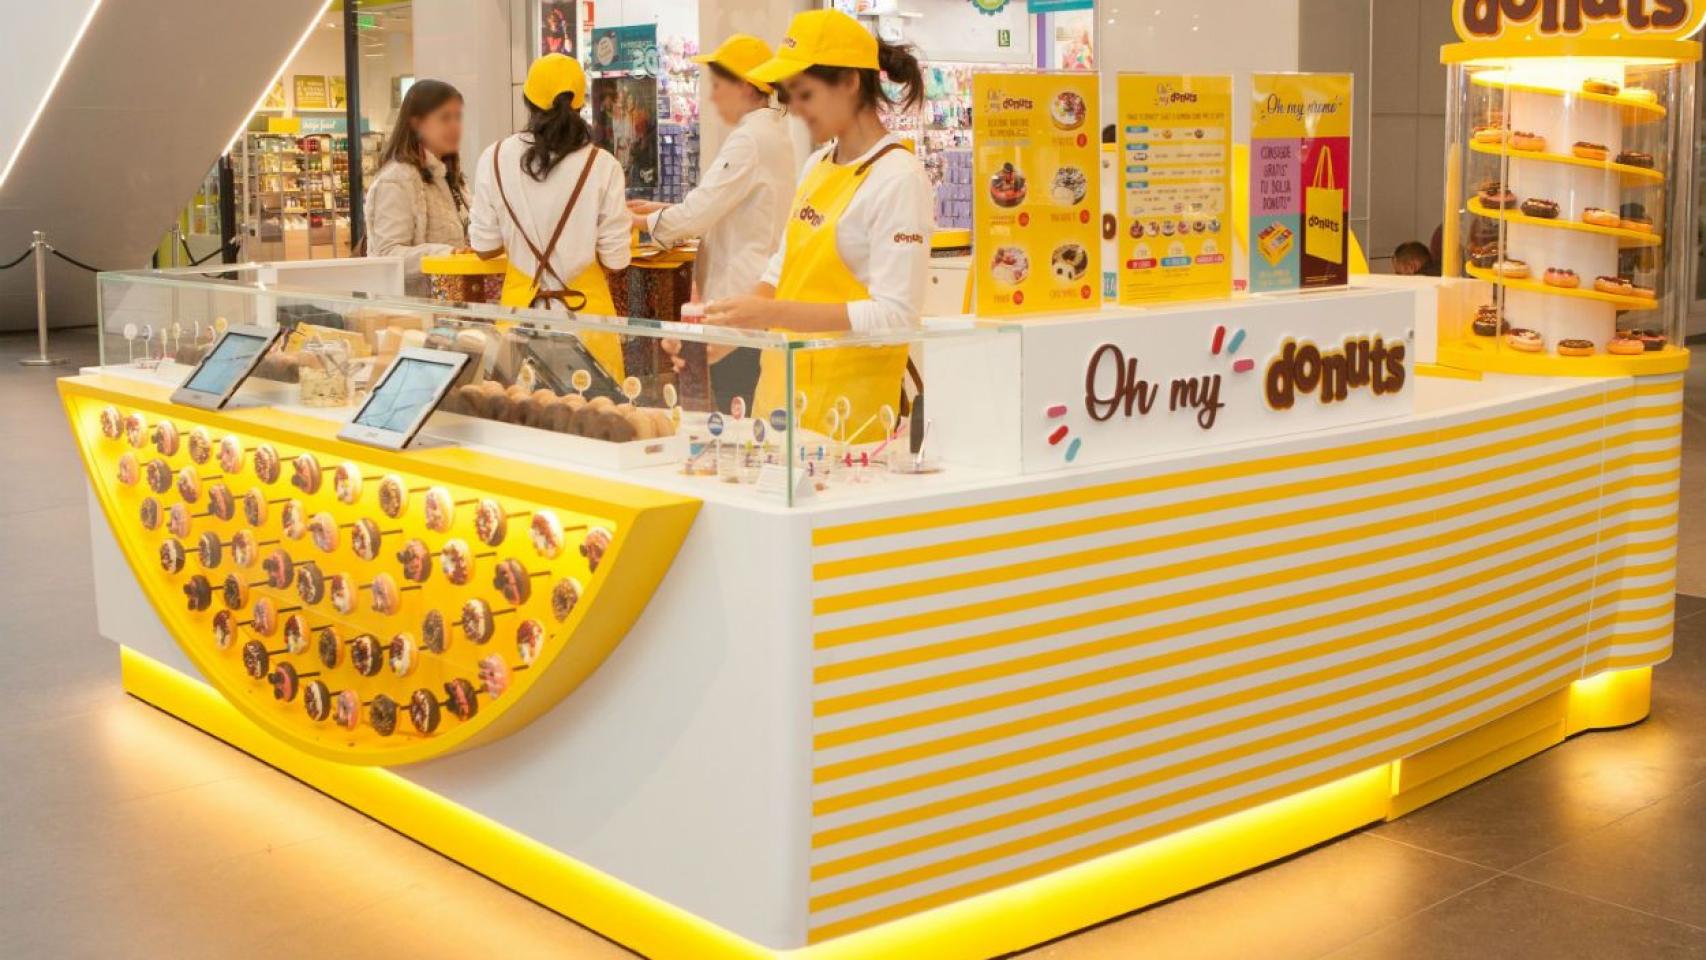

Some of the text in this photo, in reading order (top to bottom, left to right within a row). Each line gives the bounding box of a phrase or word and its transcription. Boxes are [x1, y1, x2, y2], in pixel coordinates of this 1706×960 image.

[1267, 93, 1284, 114] Oh
[1308, 215, 1339, 233] donuts
[1085, 334, 1406, 430] Oh my donuts
